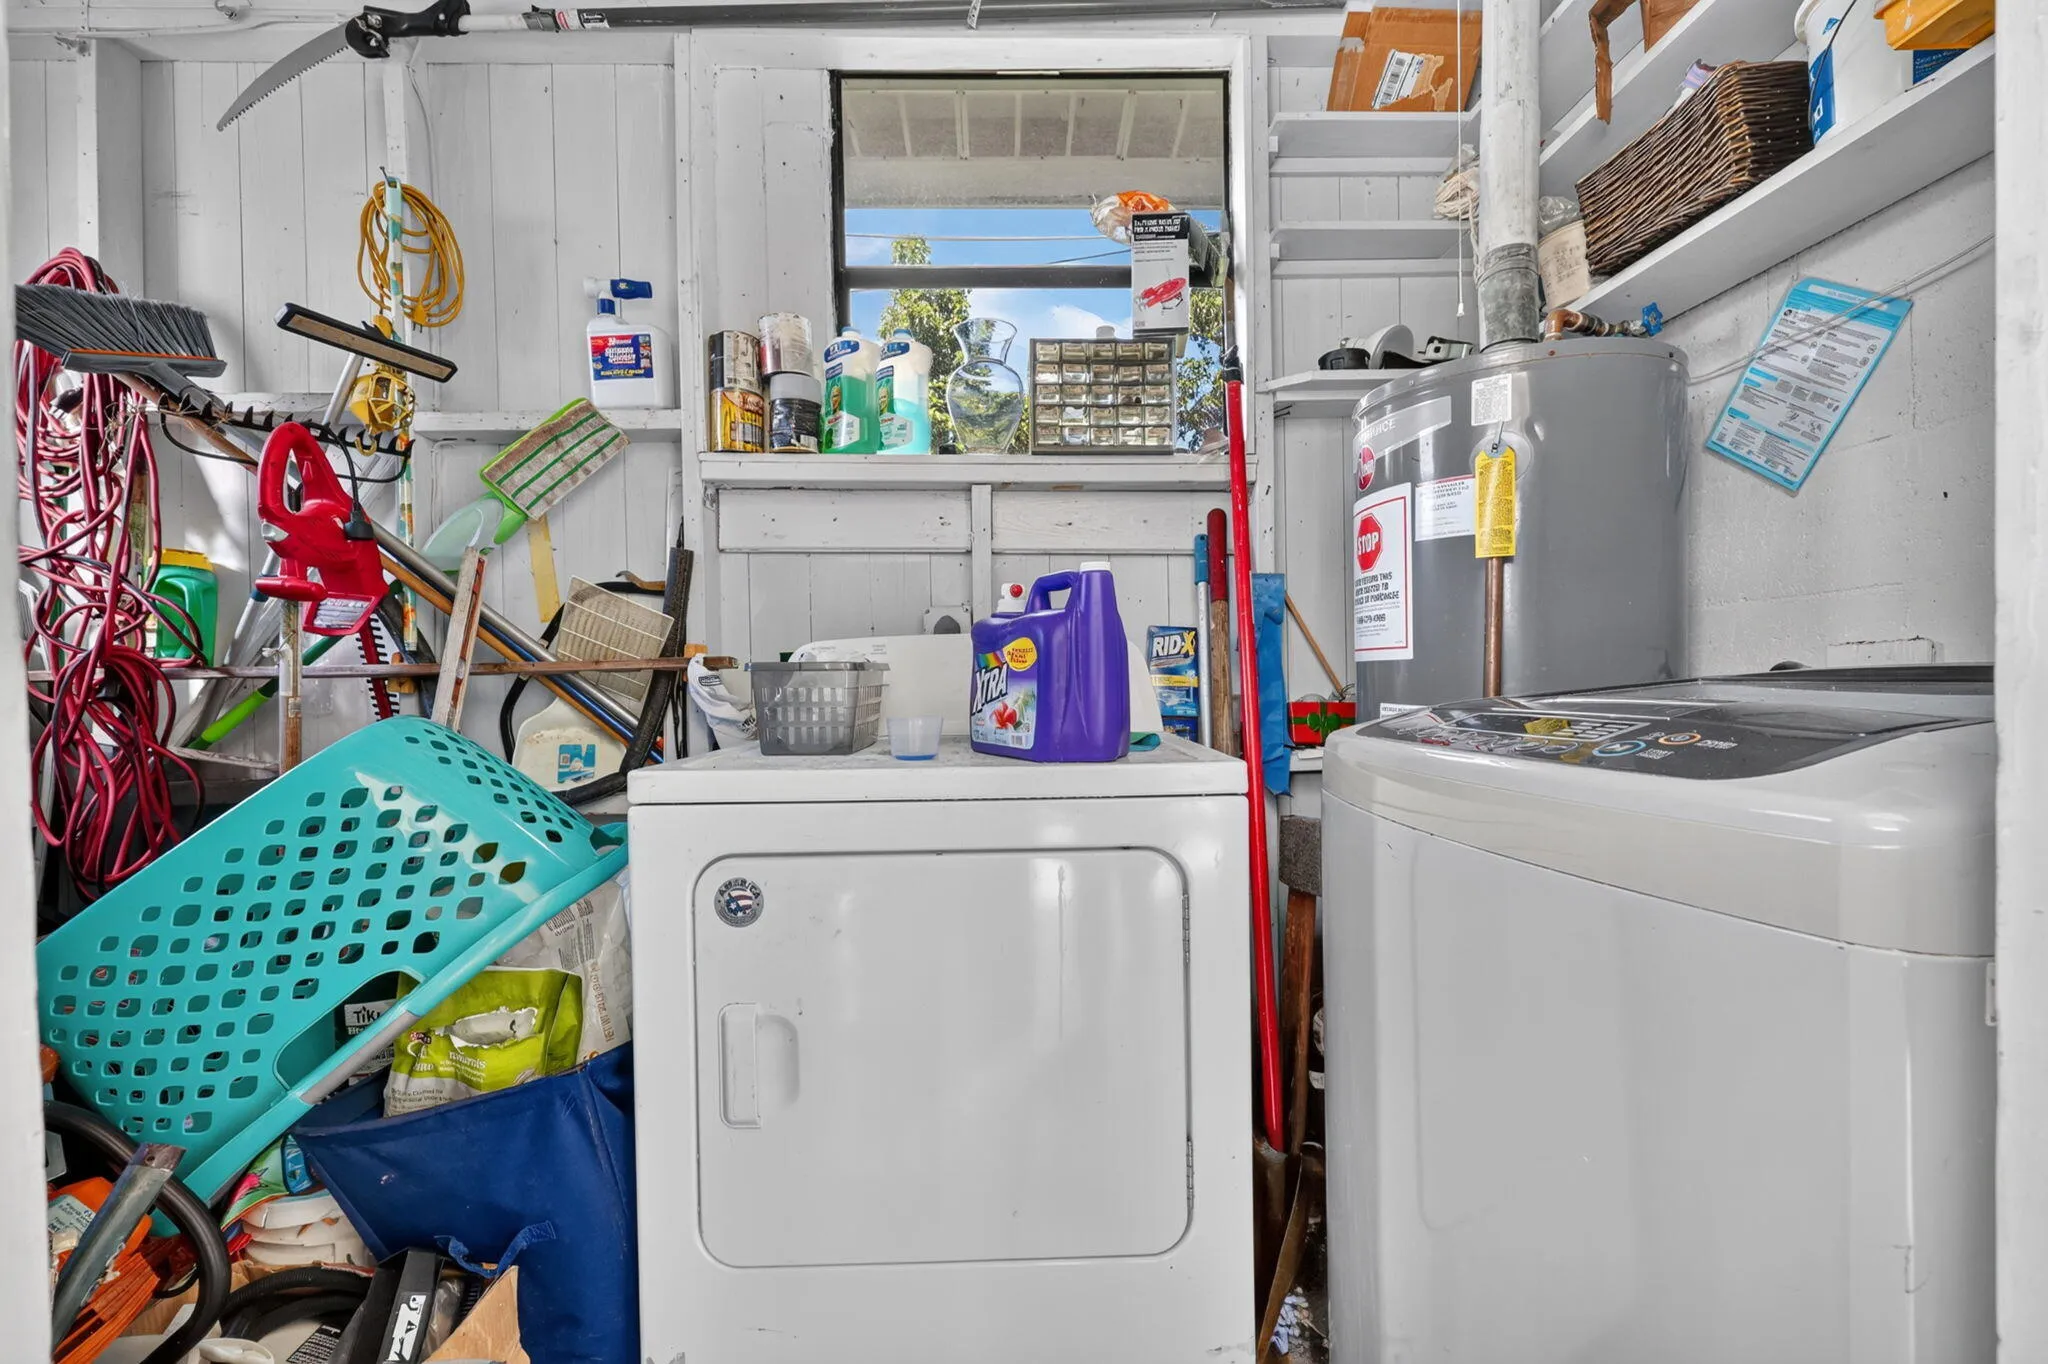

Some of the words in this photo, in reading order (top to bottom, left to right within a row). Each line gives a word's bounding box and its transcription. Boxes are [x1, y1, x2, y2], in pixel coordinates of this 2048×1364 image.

[1357, 532, 1380, 556] STOP
[1152, 631, 1196, 658] RID-X
[972, 662, 1009, 714] XTRA
